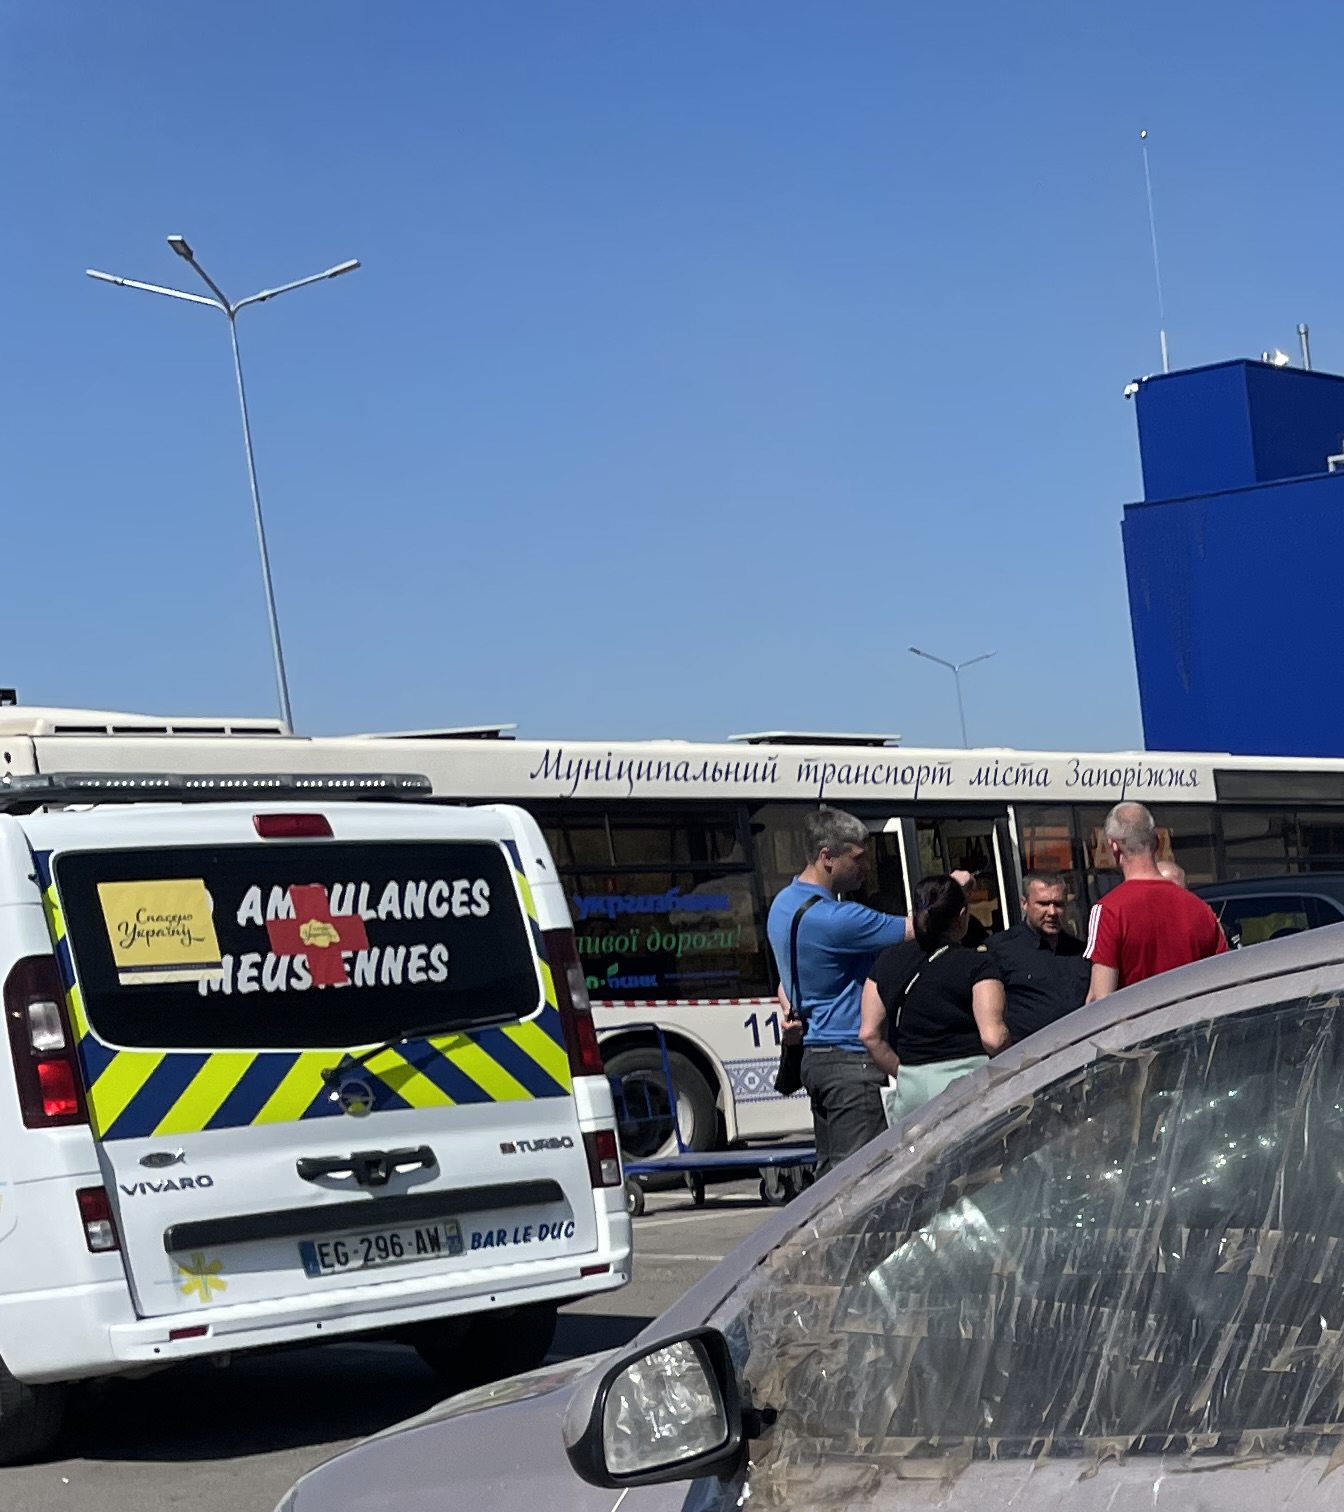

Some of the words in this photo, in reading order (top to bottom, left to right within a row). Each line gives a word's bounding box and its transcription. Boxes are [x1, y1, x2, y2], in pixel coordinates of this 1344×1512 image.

[530, 748, 780, 798] Муніципальний
[797, 757, 954, 799] транспорт
[968, 759, 1051, 788] міста
[1065, 758, 1201, 800] Запоріжжя
[237, 879, 490, 927] AMULANCES
[117, 919, 206, 949] Україну
[647, 923, 742, 958] дороги!
[198, 943, 449, 996] MEUSENNES
[120, 1174, 214, 1197] VIVARO
[471, 1231, 508, 1251] BAR
[513, 1225, 533, 1245] LE
[538, 1219, 576, 1241] DUC
